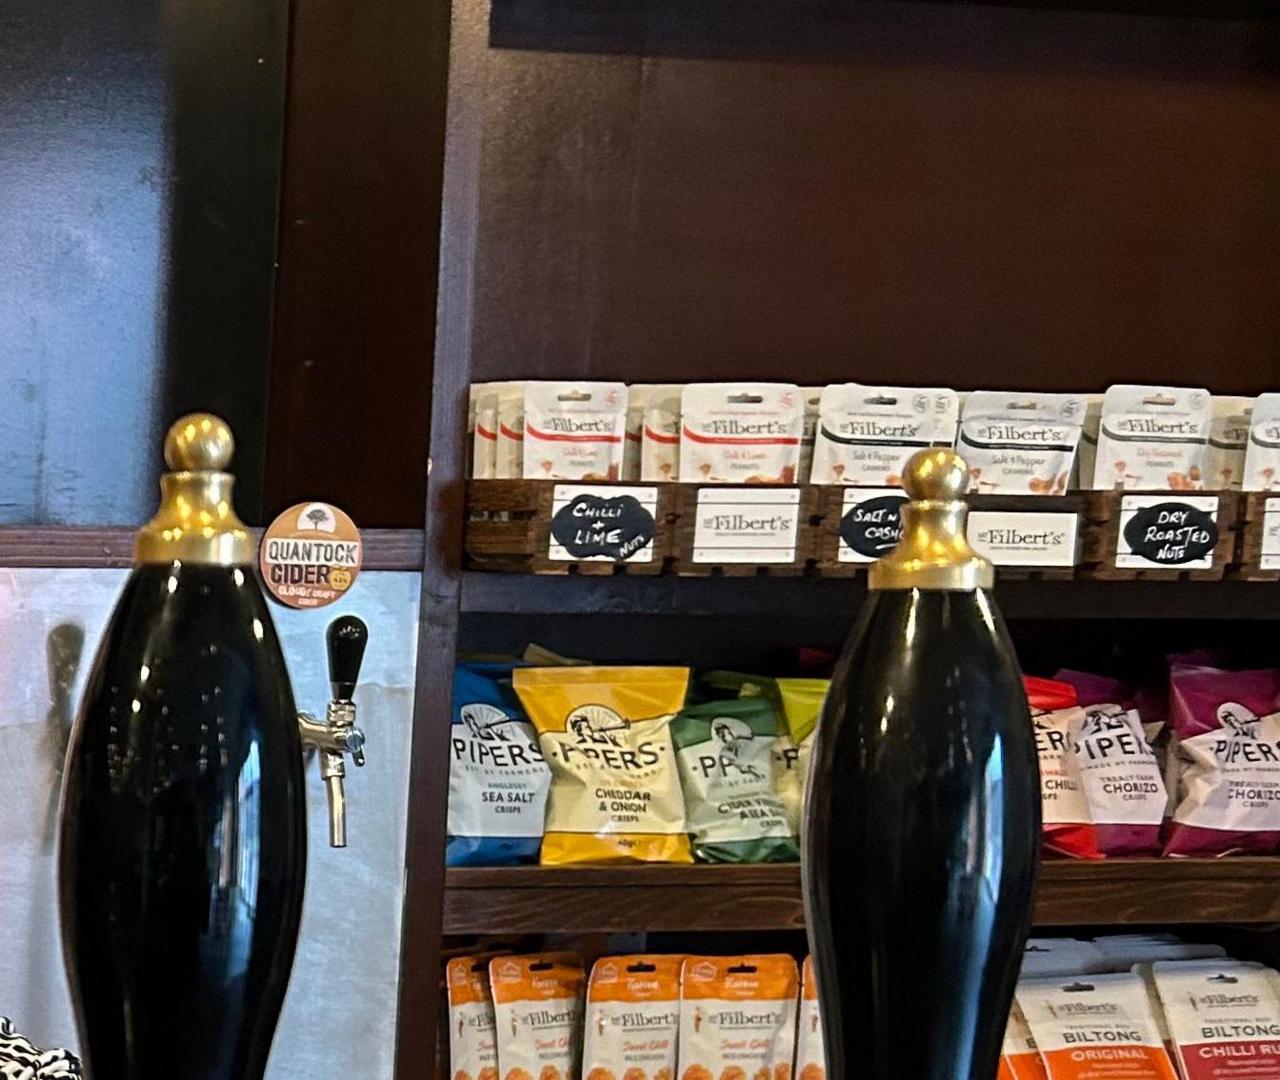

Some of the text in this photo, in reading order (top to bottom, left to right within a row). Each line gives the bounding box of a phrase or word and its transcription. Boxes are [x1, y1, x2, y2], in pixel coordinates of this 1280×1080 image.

[550, 416, 613, 433] Filbert's
[711, 420, 788, 436] Filbert's
[848, 421, 919, 438] Filbert's
[1126, 418, 1200, 434] Filbert's
[987, 425, 1063, 442] Filbert's
[572, 502, 624, 518] CHILLI
[853, 508, 887, 523] SALT
[1157, 511, 1189, 525] DRY
[713, 514, 790, 532] Filbert's
[574, 528, 622, 546] LIME
[988, 528, 1063, 546] Filbert's
[1143, 526, 1211, 548] ROASTED
[268, 541, 358, 563] QUANTOCK
[1156, 543, 1186, 560] NUTS
[270, 564, 331, 585] CIDER
[452, 737, 545, 768] PIPERS
[595, 788, 652, 801] CHEDDAR
[1102, 782, 1159, 794] CHORIZO
[481, 791, 536, 804] SEA SALT
[494, 805, 521, 814] CRISPS
[599, 802, 647, 813] & ONION
[1062, 1031, 1142, 1044] BILTONG
[1201, 1024, 1280, 1039] BILTONG
[1071, 1050, 1149, 1062] ORIGINAL
[1199, 1044, 1257, 1058] CHILLI
